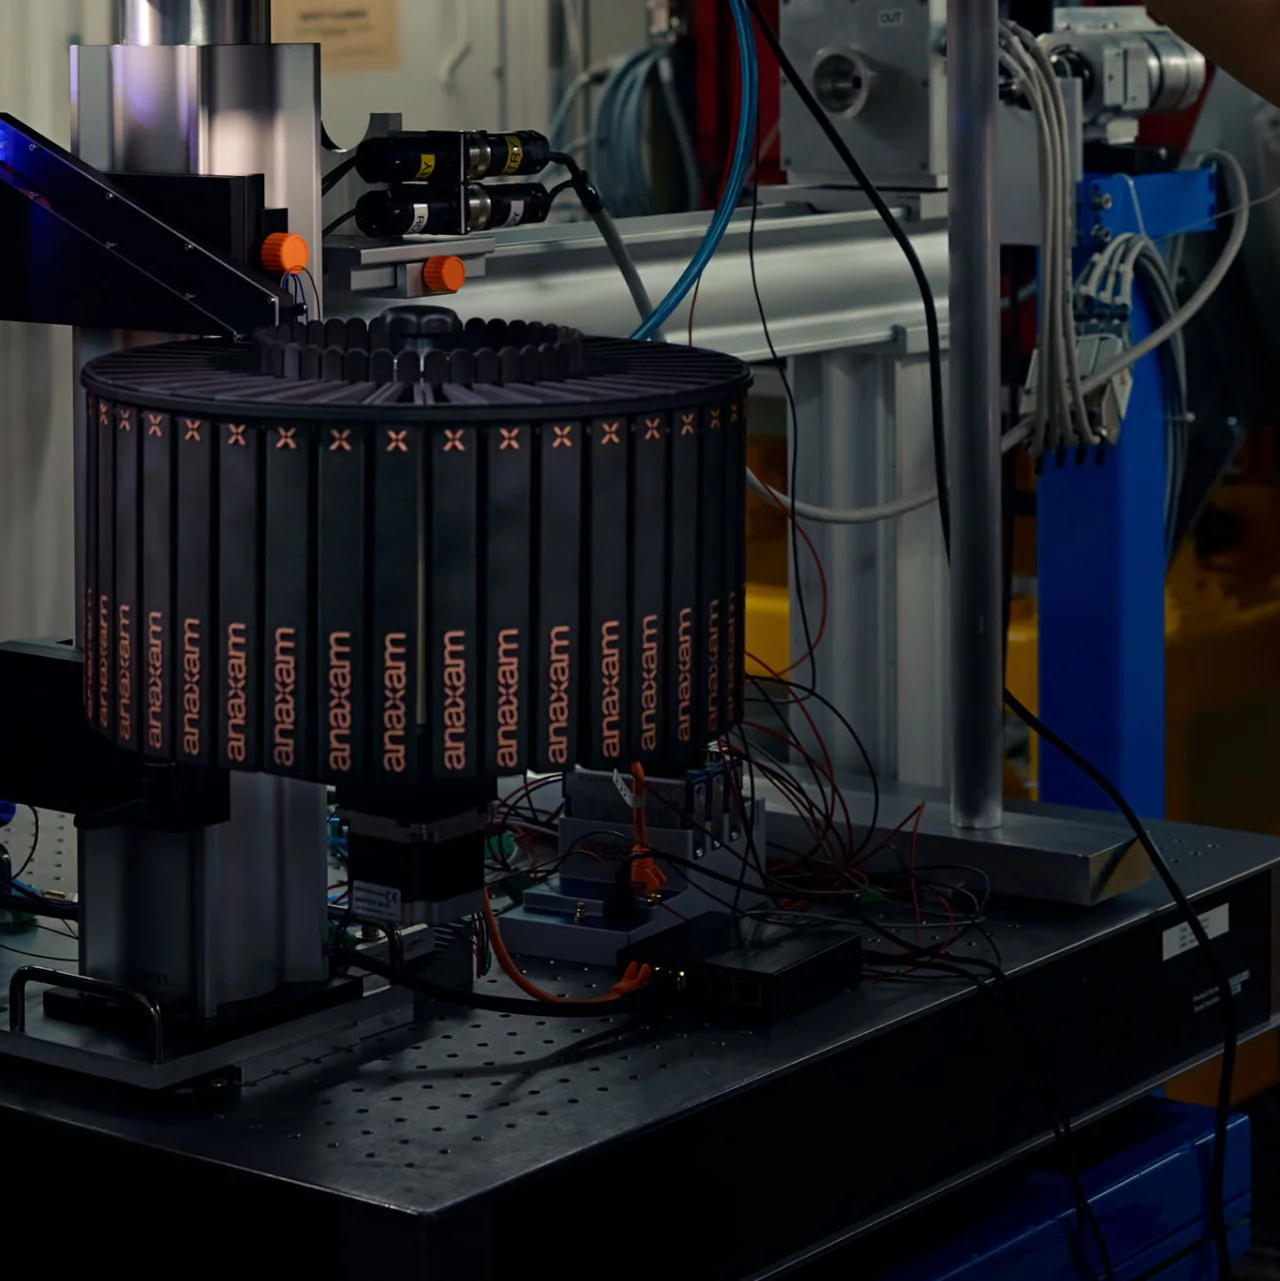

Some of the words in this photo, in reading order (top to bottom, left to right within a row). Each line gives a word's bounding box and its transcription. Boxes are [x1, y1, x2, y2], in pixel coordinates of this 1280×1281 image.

[120, 604, 131, 740] anaxam
[148, 611, 163, 749] anaxam
[183, 617, 200, 756] anaxam
[227, 622, 247, 762] anaxam
[273, 627, 295, 767] anaxam
[329, 631, 351, 772] anaxam
[383, 632, 407, 773] anaxam
[443, 630, 466, 771] anaxam
[497, 628, 519, 768] anaxam
[548, 625, 570, 764] anaxam
[602, 620, 620, 758] anaxam
[641, 614, 658, 751] anaxam
[678, 607, 691, 742] anaxam
